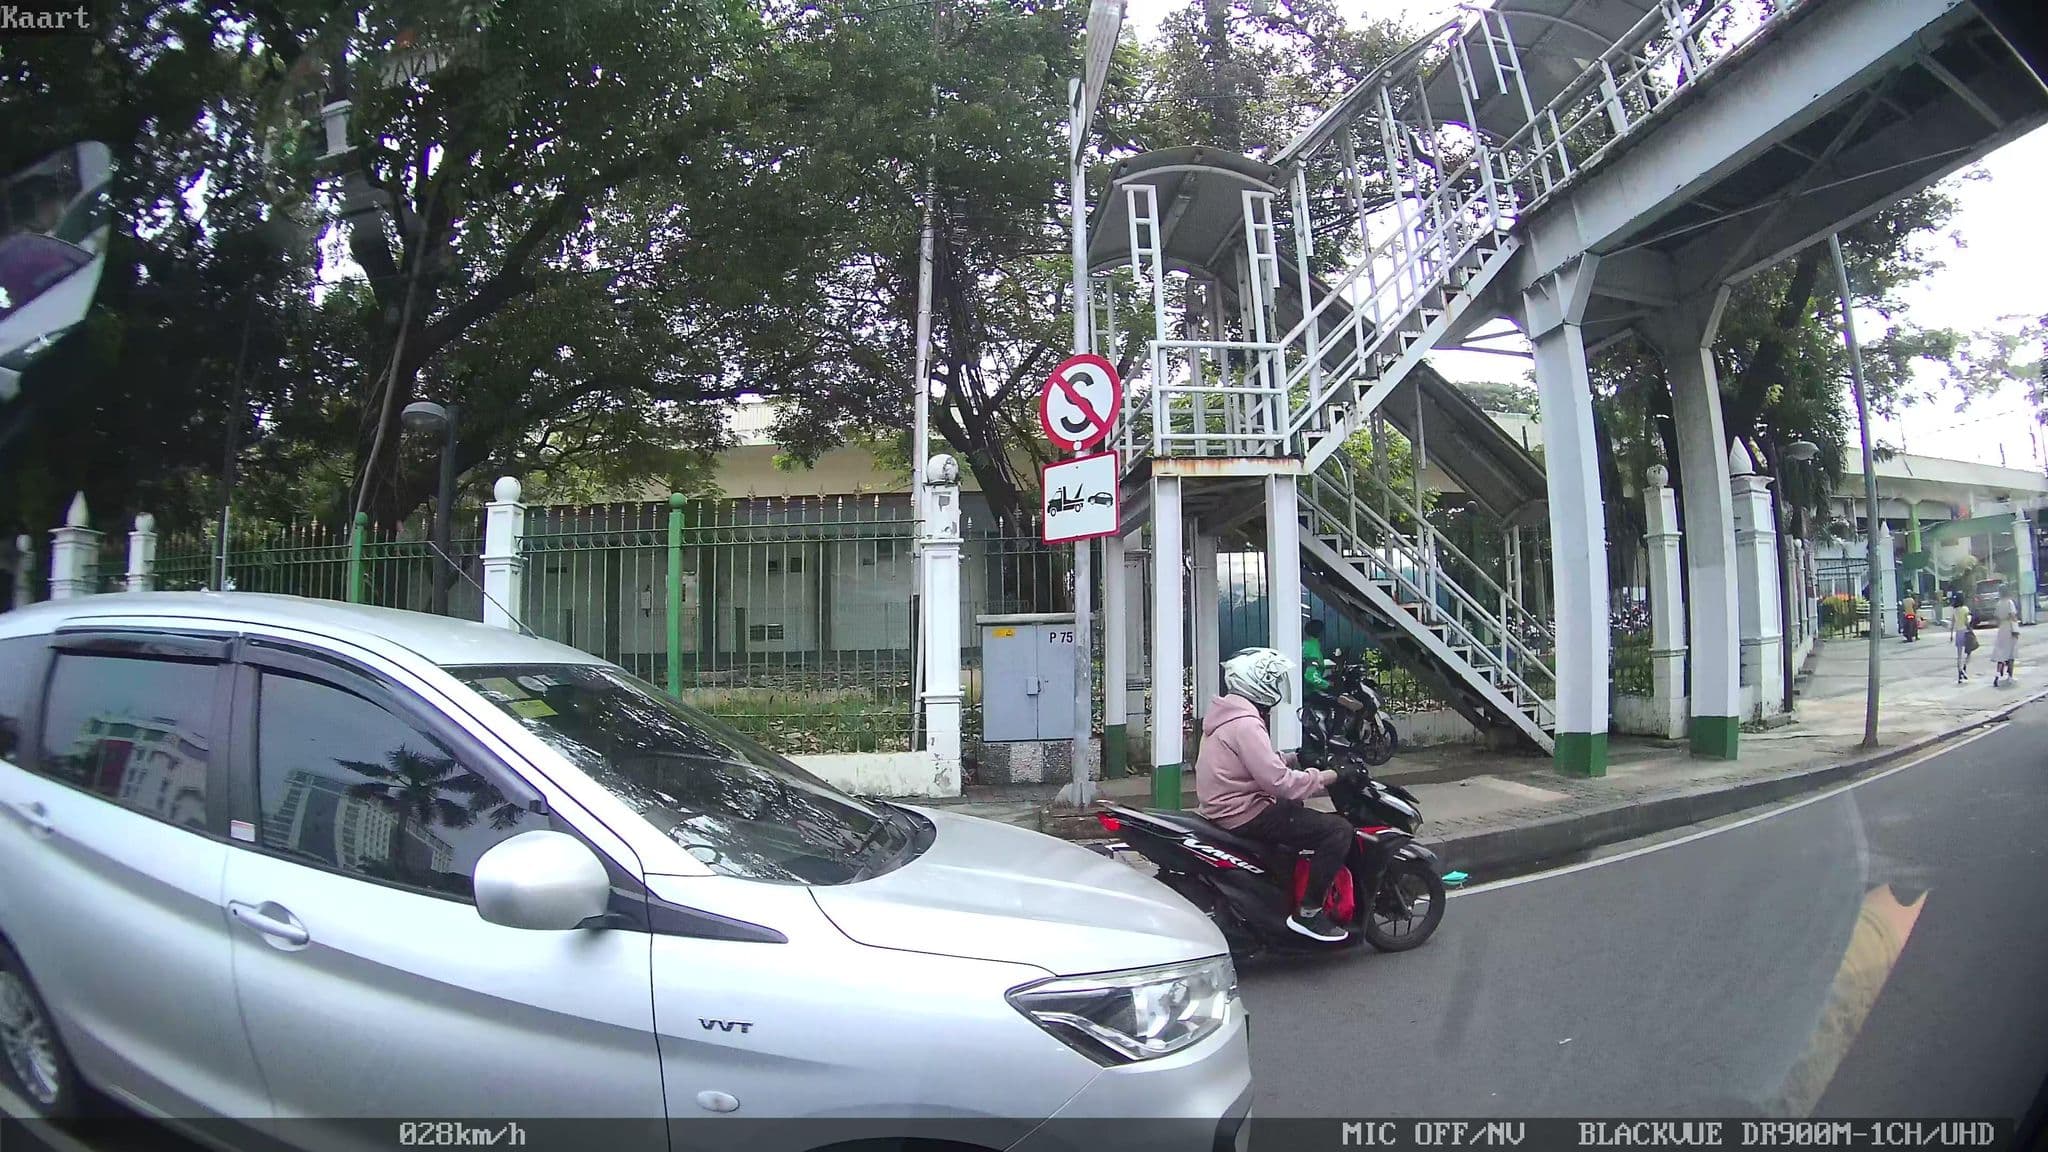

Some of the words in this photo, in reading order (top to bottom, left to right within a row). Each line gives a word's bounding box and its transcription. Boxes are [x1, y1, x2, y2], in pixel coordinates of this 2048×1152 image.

[1060, 371, 1094, 434] S
[1049, 631, 1057, 643] P
[1060, 631, 1073, 643] 75
[1182, 838, 1264, 874] VARIO
[697, 1016, 753, 1034] VVT
